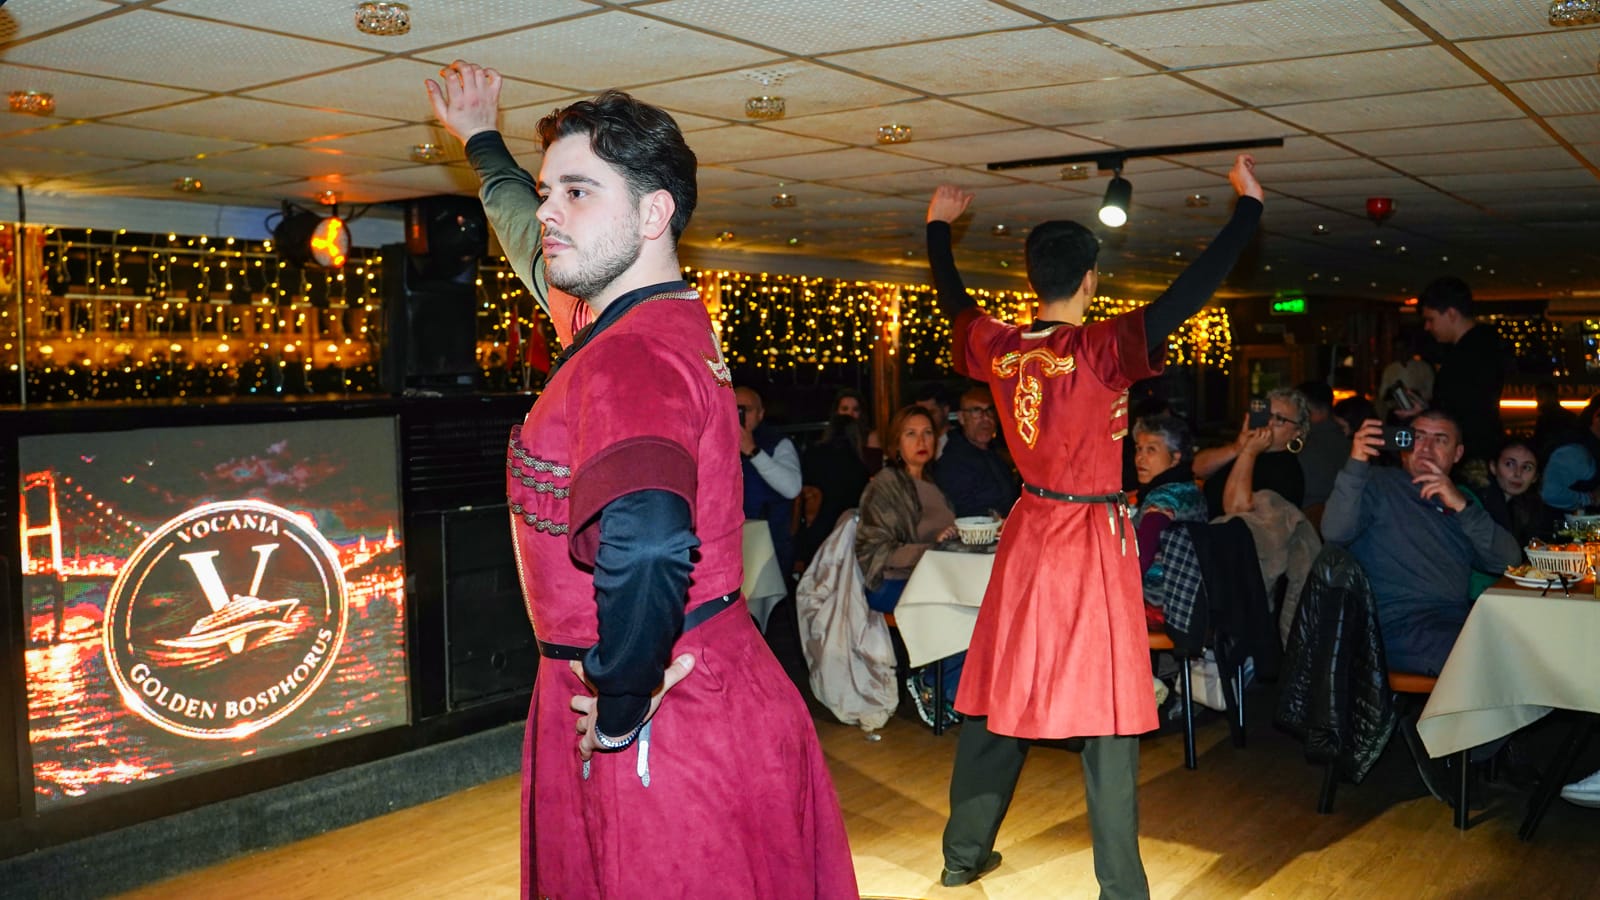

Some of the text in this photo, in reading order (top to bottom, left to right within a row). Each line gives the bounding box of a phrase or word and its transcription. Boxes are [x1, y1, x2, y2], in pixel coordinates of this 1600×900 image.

[176, 514, 279, 543] VOCANIA
[178, 543, 280, 654] V
[130, 627, 333, 719] GOLDEN BOSPHORUS
